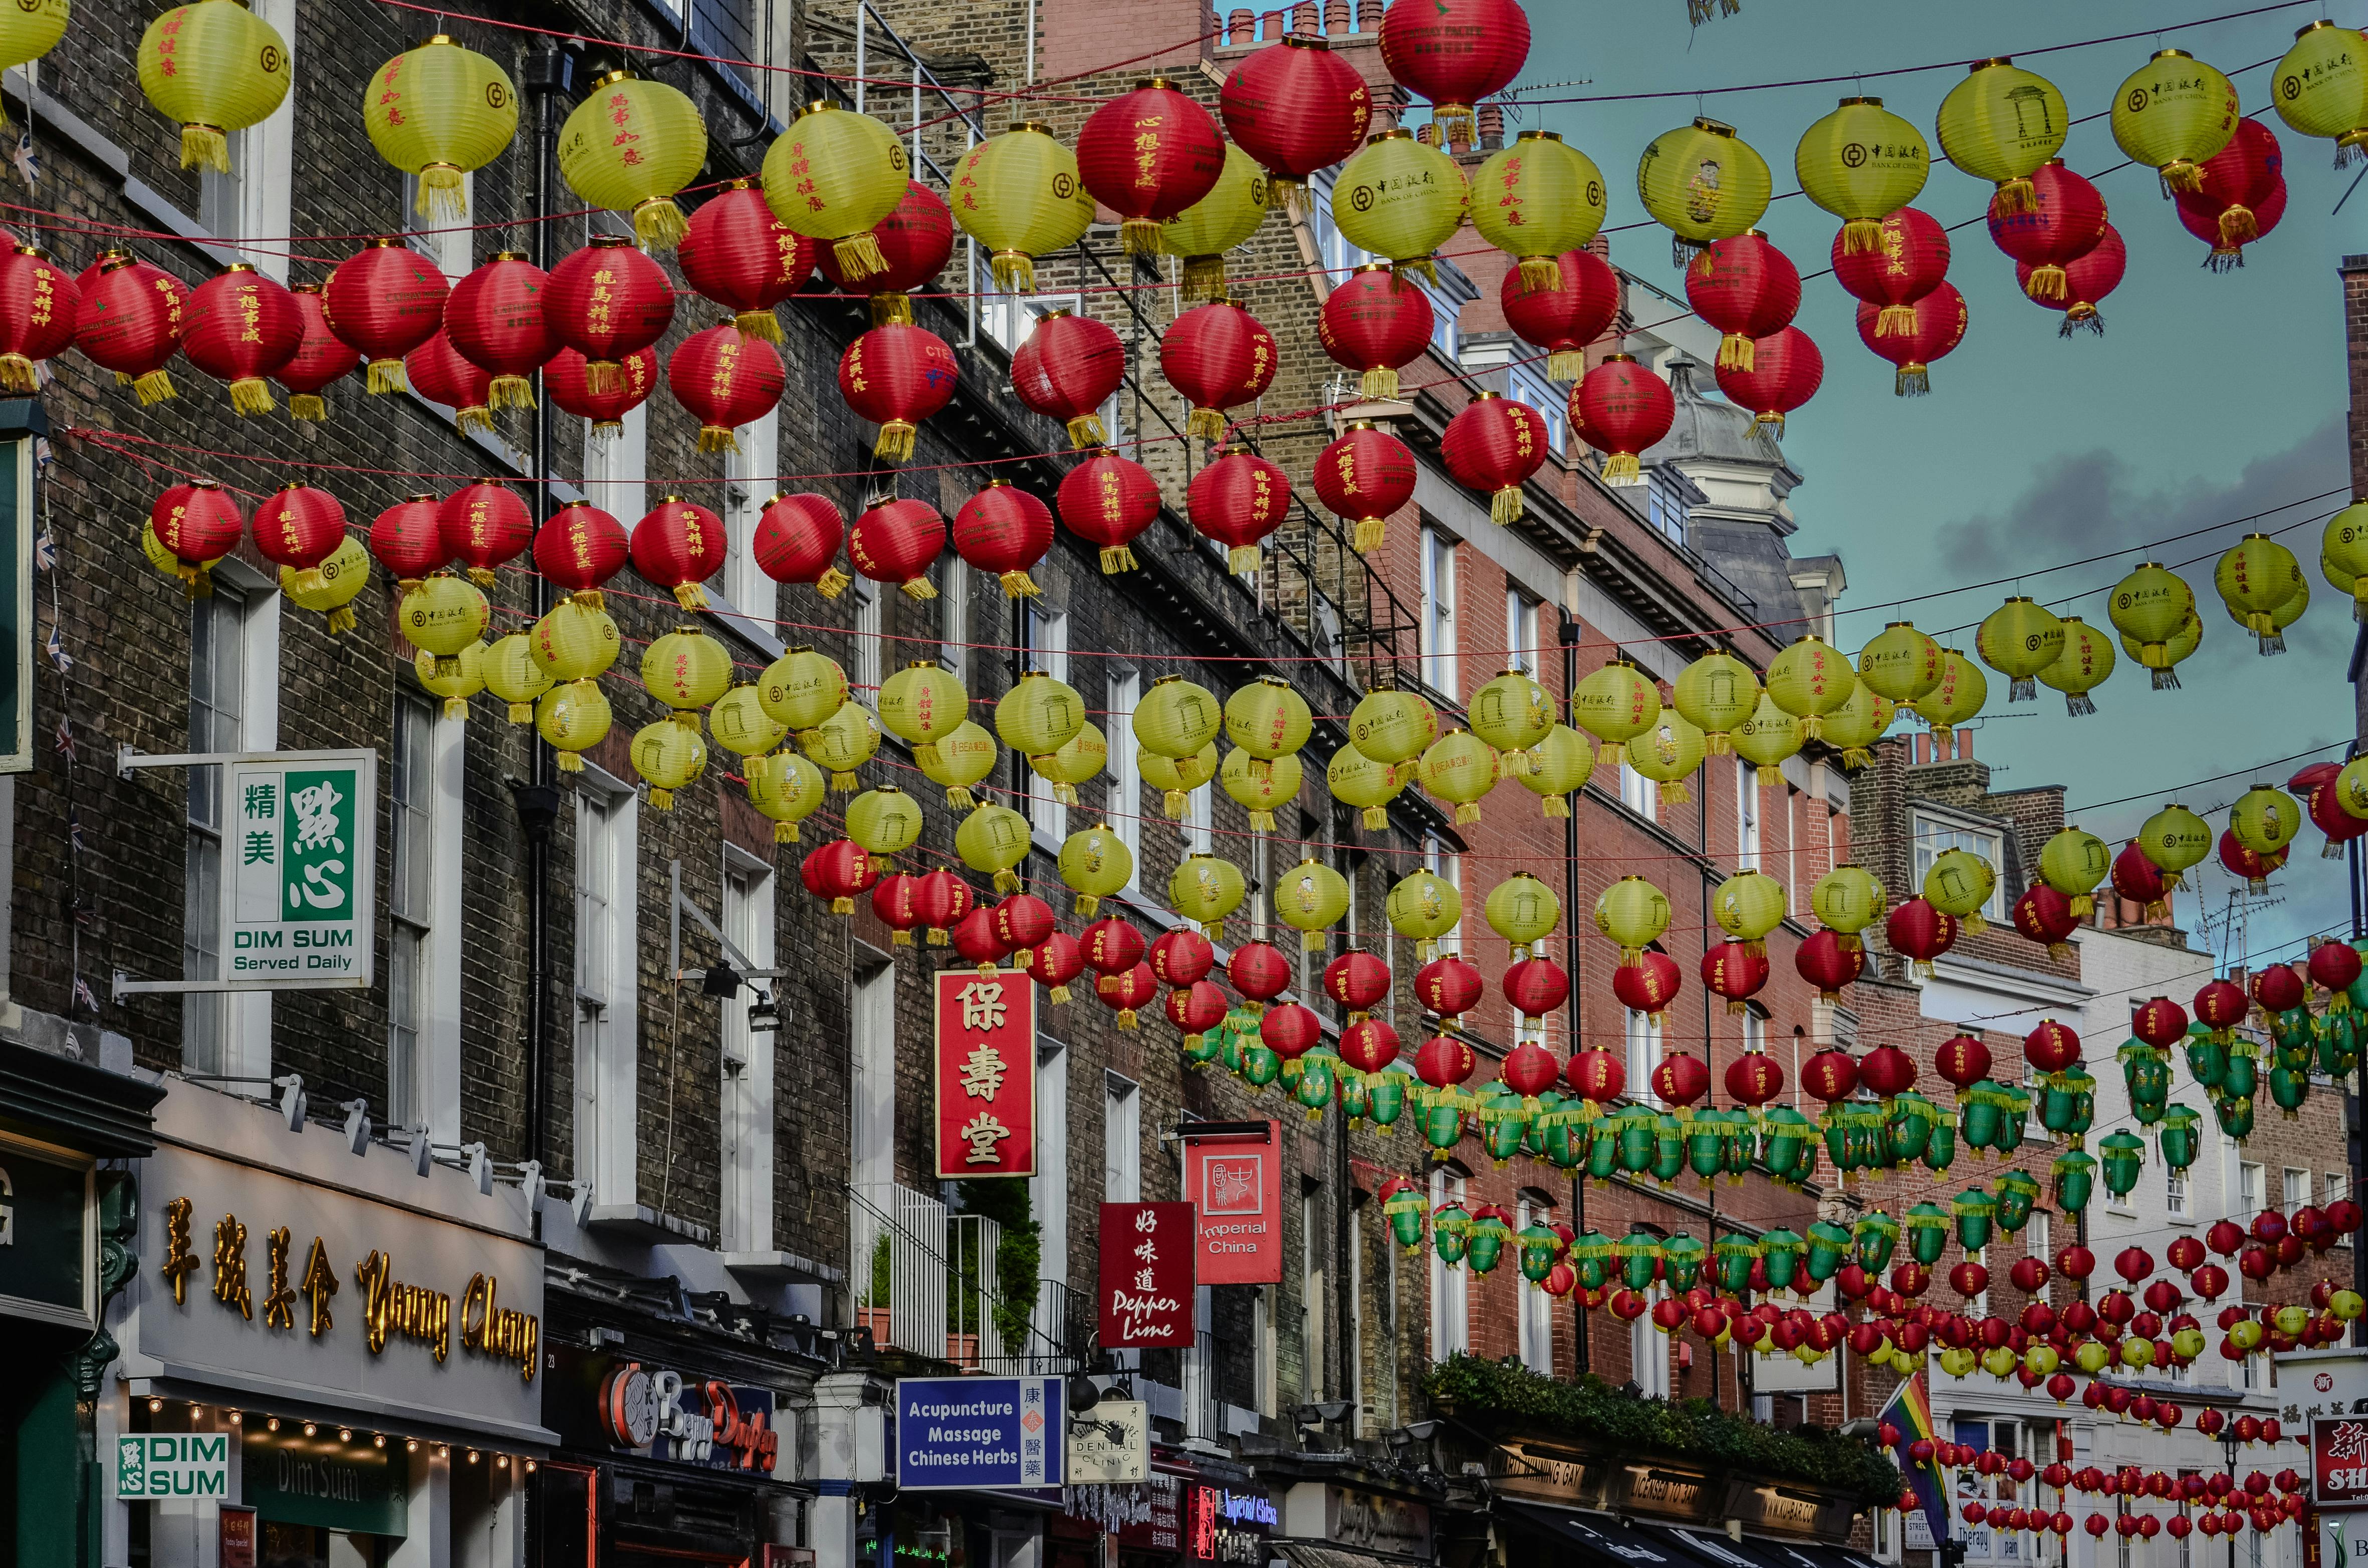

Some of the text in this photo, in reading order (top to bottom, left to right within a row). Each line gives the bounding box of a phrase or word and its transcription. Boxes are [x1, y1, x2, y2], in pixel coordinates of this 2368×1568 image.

[1403, 25, 1485, 39] CATHAY PACIFIC
[608, 93, 644, 168] 萬事如意
[1134, 116, 1163, 189] 心想事成
[790, 142, 827, 214] 身體健康
[1500, 158, 1527, 227] 萬事如意
[31, 268, 56, 327] 龍馬精神
[236, 285, 263, 344] 心想事成
[587, 270, 617, 336] 龍馬精神
[1340, 297, 1405, 310] CATHAY PACIFIC
[711, 344, 740, 401] 龍馬精神
[1507, 408, 1533, 458] 龍馬精神
[1336, 443, 1362, 496] 心想事成
[1101, 472, 1121, 522] 龍馬精神
[1252, 470, 1271, 522] 龍馬精神
[470, 501, 490, 548] 心想事成
[568, 520, 595, 570] 心想事成
[680, 510, 704, 557] 龍馬精神
[673, 654, 690, 699] 萬事如意
[1811, 651, 1827, 696] 萬事如意
[918, 687, 932, 731] 身體健康
[1631, 681, 1645, 725] 身體健康
[1271, 707, 1287, 750] 身體健康
[1437, 761, 1450, 773] BEA
[244, 783, 276, 866] 精美
[289, 780, 345, 909] 點心
[234, 929, 353, 948] DIM SUM
[234, 954, 352, 971] Served Daily
[956, 982, 1011, 1164] 保壽堂
[1133, 1209, 1159, 1292] 好味道
[1200, 1221, 1266, 1239] Imperial
[1209, 1241, 1257, 1253] China
[1112, 1290, 1180, 1319] Pepper
[1123, 1316, 1174, 1341] Lime
[548, 1354, 555, 1368] 23
[909, 1401, 1013, 1421] Acupuncture
[1025, 1387, 1042, 1477] 康泰醫藥
[150, 1437, 225, 1462] DIM
[909, 1448, 1018, 1466] Chinese Herbs
[928, 1426, 1001, 1445] Massage
[1077, 1441, 1136, 1452] DENTAL
[121, 1441, 142, 1491] 點心
[278, 1448, 314, 1495] Dim
[320, 1455, 360, 1502] Sum
[1082, 1454, 1131, 1466] CLINIC
[1562, 1463, 1581, 1487] GAY
[149, 1470, 225, 1495] SUM
[1631, 1476, 1699, 1504] LICENSED TO 3AM
[1152, 1511, 1176, 1529] 小笼包饺子
[1762, 1496, 1818, 1524] WWW.KU-BAR.COM
[225, 1538, 248, 1548] Today Special
[1152, 1530, 1176, 1548] 各式粉面饭
[1959, 1527, 1988, 1551] Therapy
[2005, 1540, 2018, 1555] pain
